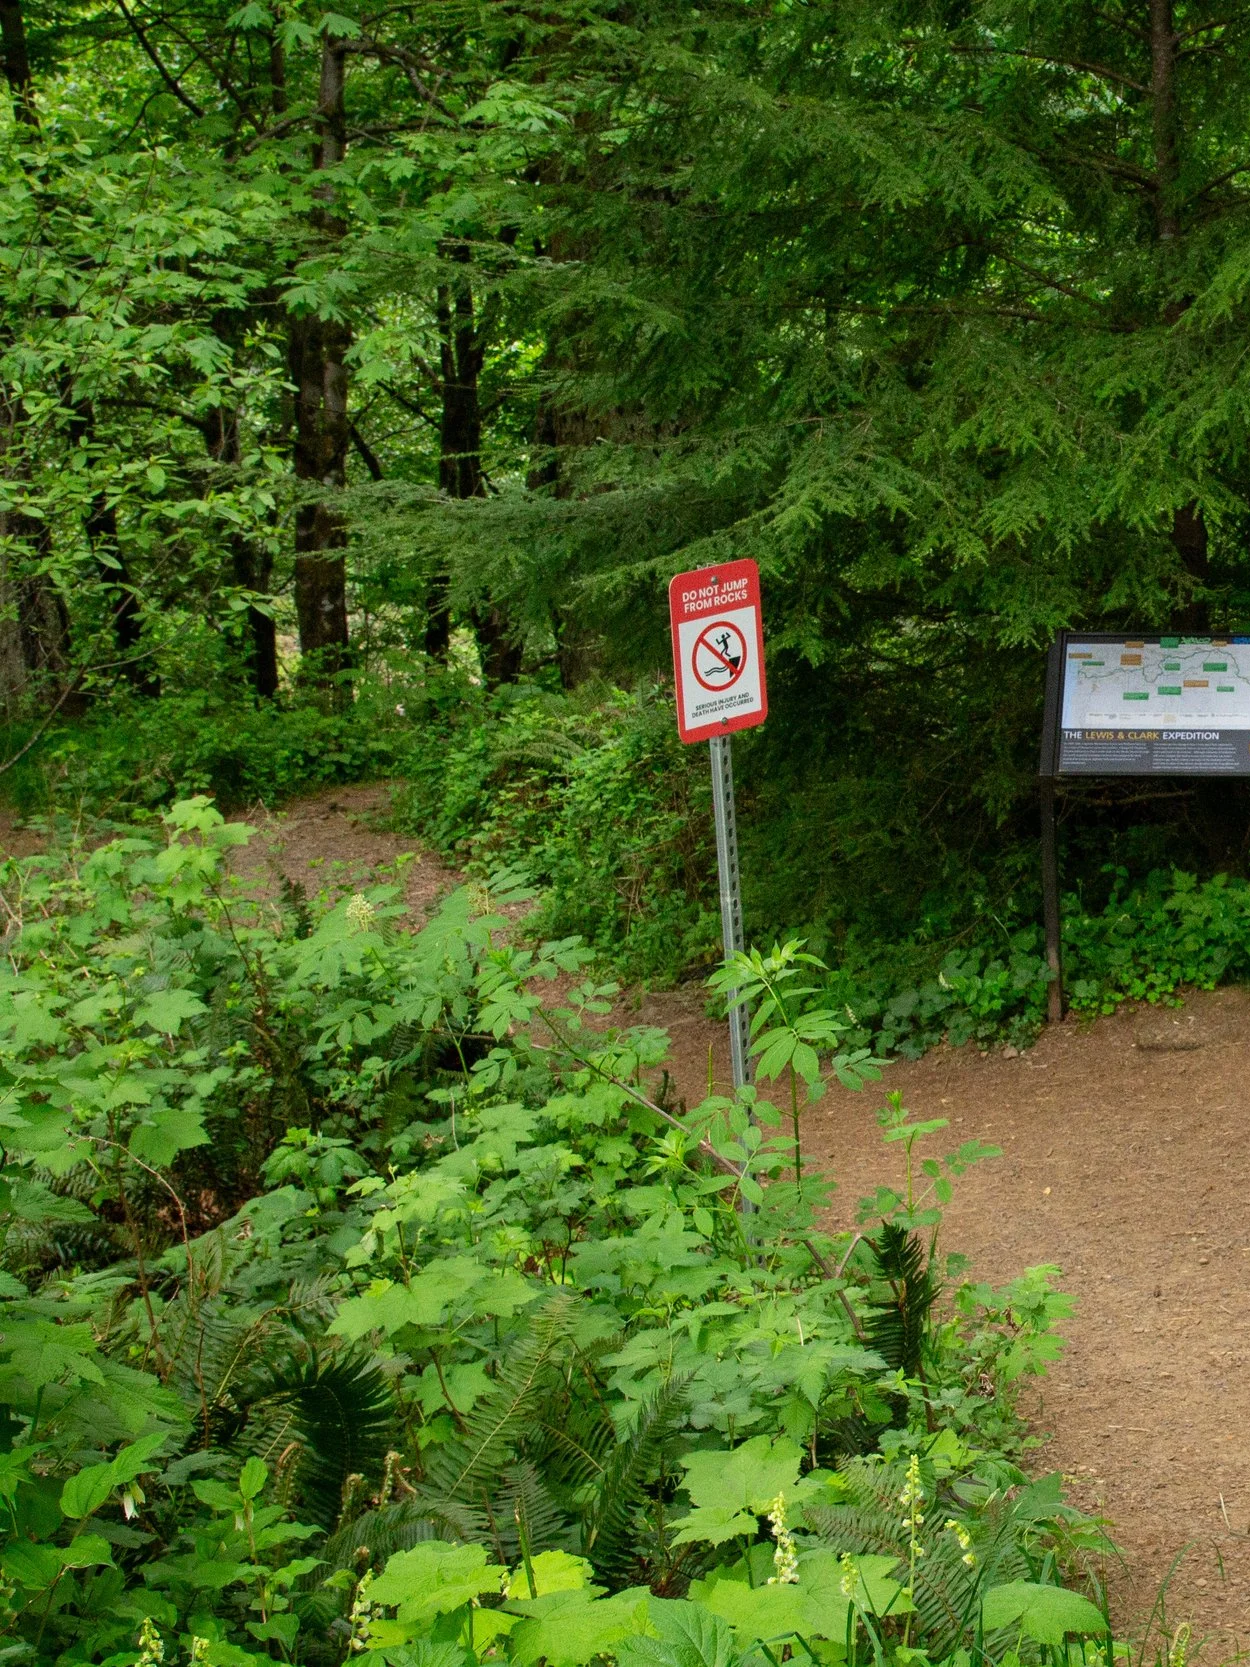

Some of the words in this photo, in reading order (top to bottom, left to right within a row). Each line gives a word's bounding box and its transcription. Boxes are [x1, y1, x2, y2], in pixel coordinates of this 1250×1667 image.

[682, 590, 697, 603] DO
[698, 584, 719, 600] NOT
[721, 578, 748, 594] JUMP
[684, 598, 712, 613] FROM
[714, 589, 747, 605] ROCKS
[692, 708, 710, 718] DEATH
[710, 704, 725, 714] HAVE
[725, 697, 753, 710] OCCURRED
[696, 701, 717, 711] SERIOUS
[718, 695, 737, 705] INJURY
[738, 692, 750, 700] AND
[1064, 731, 1082, 739] THE
[1085, 731, 1114, 739] LEWIS
[1117, 732, 1125, 740] &
[1127, 732, 1159, 740] CLARK
[1162, 731, 1220, 740] EXPEDITION
